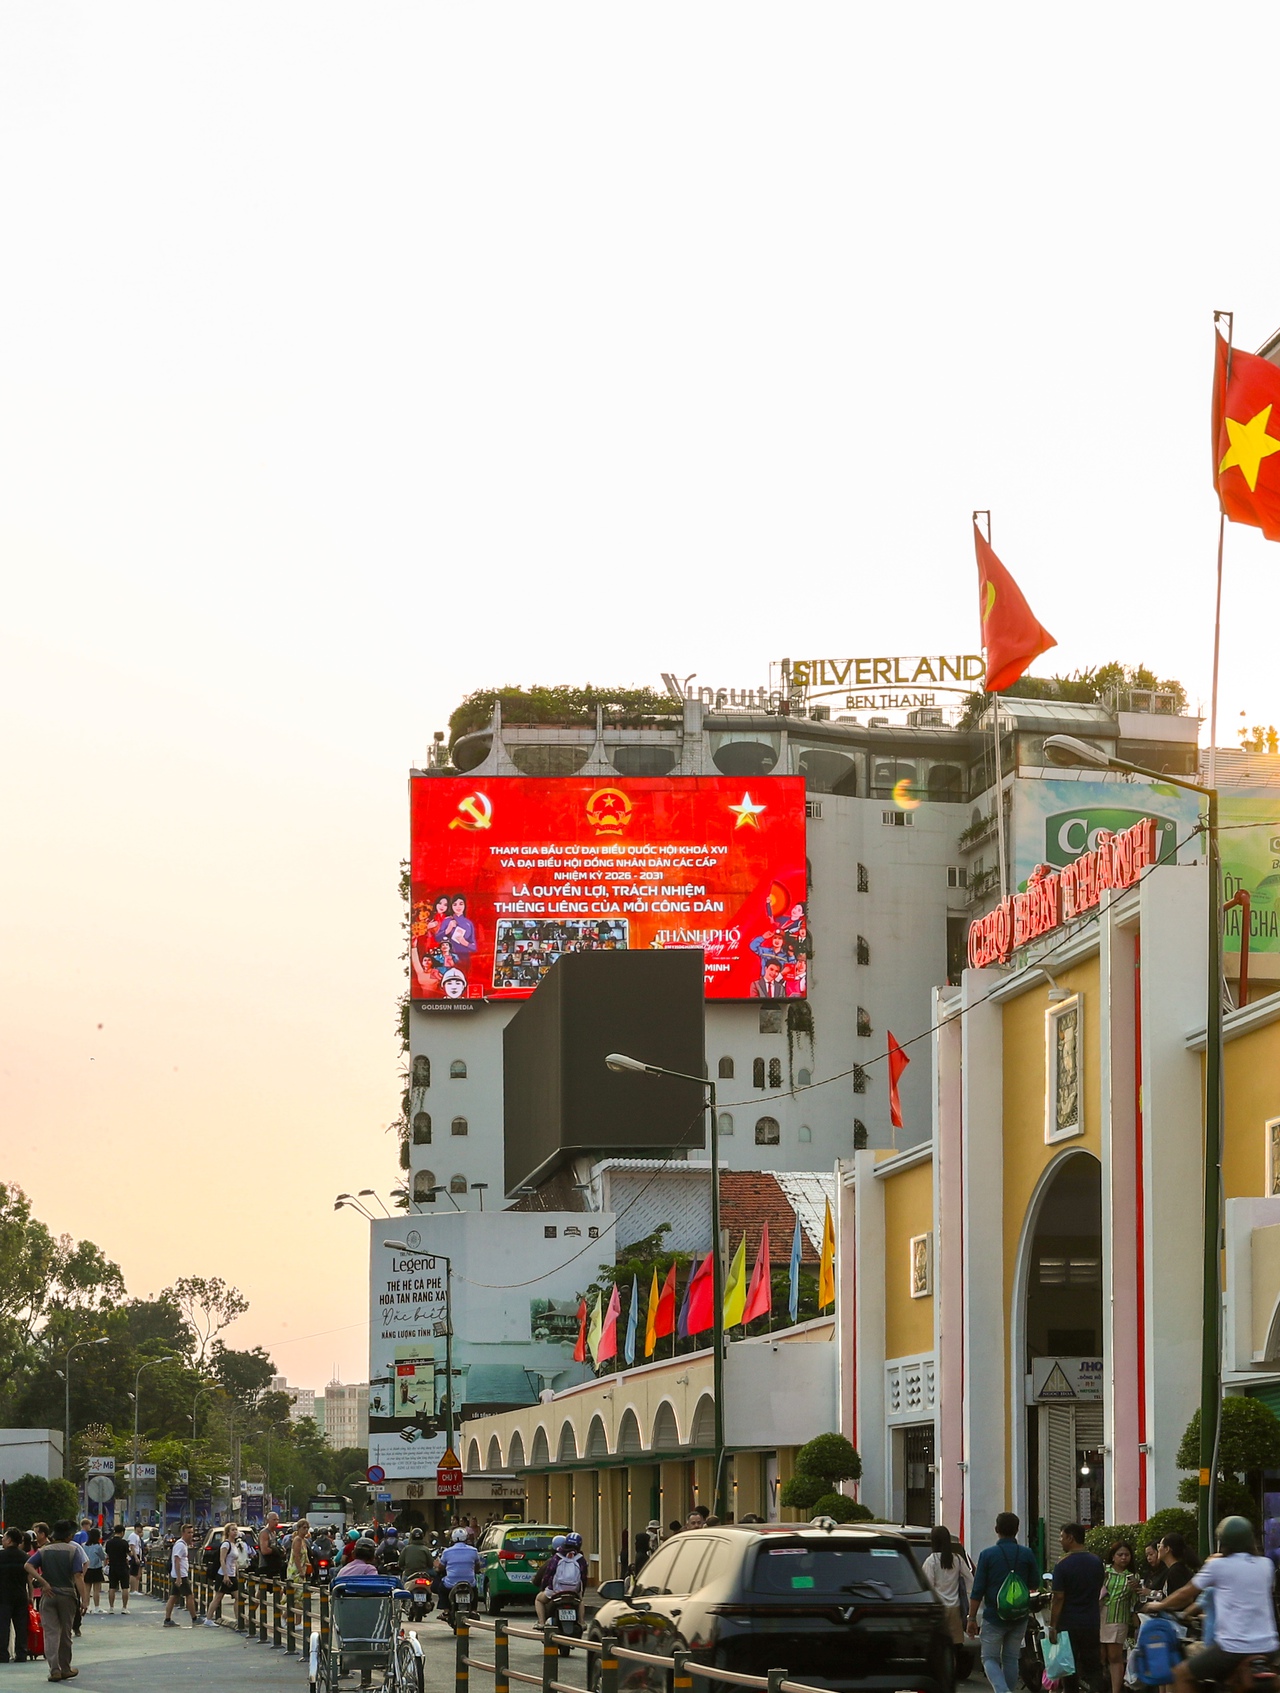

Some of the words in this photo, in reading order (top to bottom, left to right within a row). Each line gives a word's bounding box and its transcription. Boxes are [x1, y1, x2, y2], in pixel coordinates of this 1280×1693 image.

[793, 655, 987, 686] SILVERLAND
[846, 694, 875, 709] BEN
[879, 693, 935, 708] THANH
[489, 846, 519, 855] THAM
[521, 846, 539, 855] GIA
[581, 846, 599, 857] ĐẠI
[628, 843, 657, 856] QUỐC
[659, 844, 677, 857] HỘI
[679, 843, 708, 855] KHOÁ
[711, 846, 727, 854] XVI
[500, 856, 515, 867] VÀ
[517, 859, 535, 870] ĐẠI
[564, 857, 581, 870] HỘI
[616, 857, 646, 867] NHÂN
[648, 857, 670, 867] DÂN
[672, 857, 693, 867] CÁC
[554, 870, 587, 881] NHIỆM
[605, 872, 632, 880] 2026
[639, 872, 663, 880] 2031
[512, 883, 530, 896] LÀ
[532, 882, 581, 897] QUYỀN
[612, 883, 658, 896] TRÁCH
[661, 883, 705, 898] NHIỆM
[968, 895, 1014, 969] CHỢ
[1013, 864, 1061, 948] BẾN
[1060, 817, 1158, 920] THÀNH
[494, 899, 546, 912] THIÊNG
[548, 899, 589, 912] LIÊNG
[591, 898, 621, 912] CỦA
[623, 896, 648, 912] MỖI
[651, 899, 691, 912] CÔNG
[693, 899, 724, 912] DÂN
[707, 925, 741, 942] PHỐ
[704, 964, 730, 972] MINH
[392, 1257, 436, 1274] Legend
[103, 1461, 114, 1469] MB
